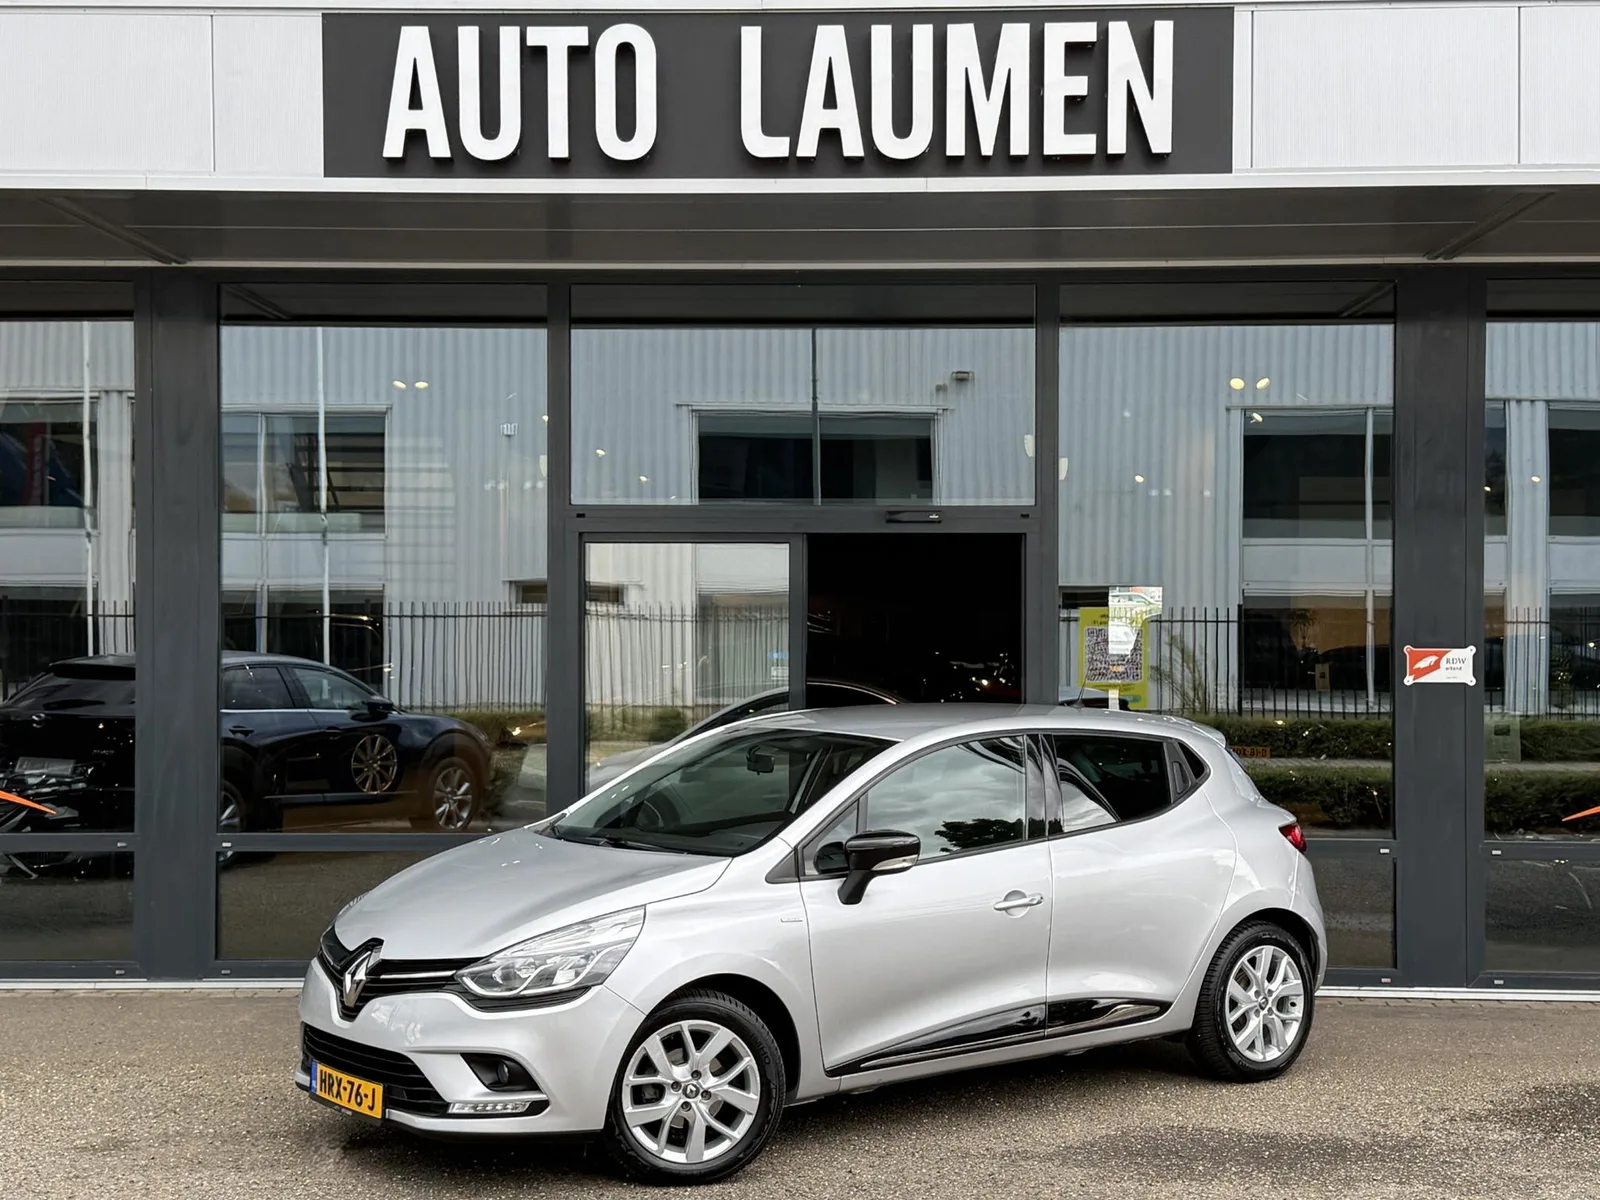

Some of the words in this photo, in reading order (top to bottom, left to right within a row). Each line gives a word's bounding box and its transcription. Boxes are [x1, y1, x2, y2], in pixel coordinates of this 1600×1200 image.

[382, 23, 657, 161] AUTO
[741, 20, 1174, 160] LAUMEN
[1445, 657, 1467, 665] RDW
[319, 1069, 376, 1112] HRX-76-J
